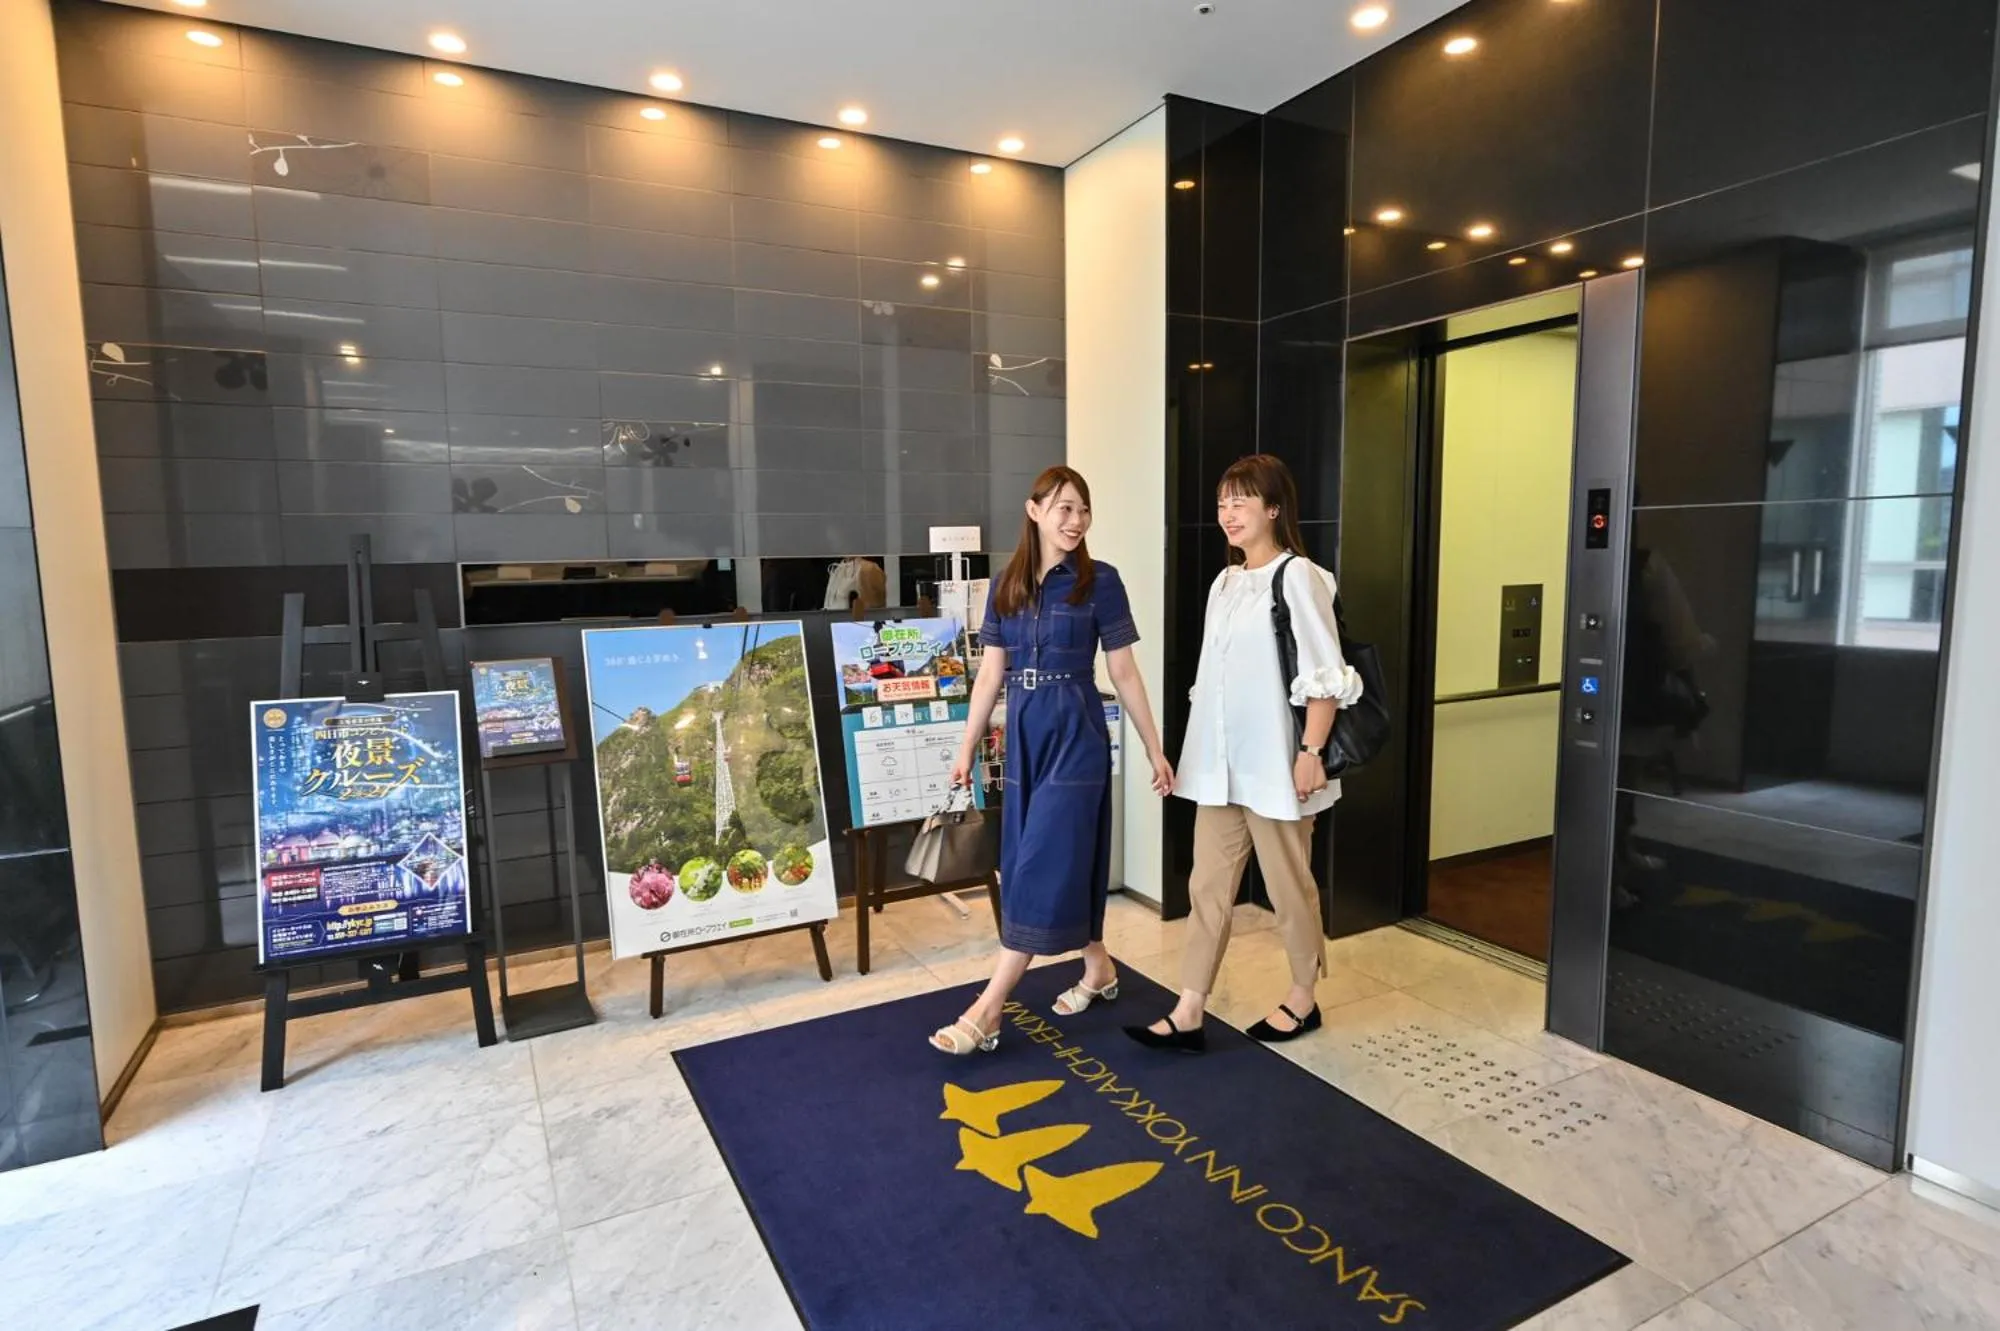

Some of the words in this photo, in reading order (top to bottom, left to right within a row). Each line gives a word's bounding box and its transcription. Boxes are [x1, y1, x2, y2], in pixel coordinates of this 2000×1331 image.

[880, 628, 921, 642] 御在所
[882, 679, 931, 693] お天気情報
[331, 736, 395, 769] 夜景
[303, 756, 426, 797] クルーズ
[1184, 1149, 1269, 1205] INN
[1256, 1202, 1427, 1325] SANCO
